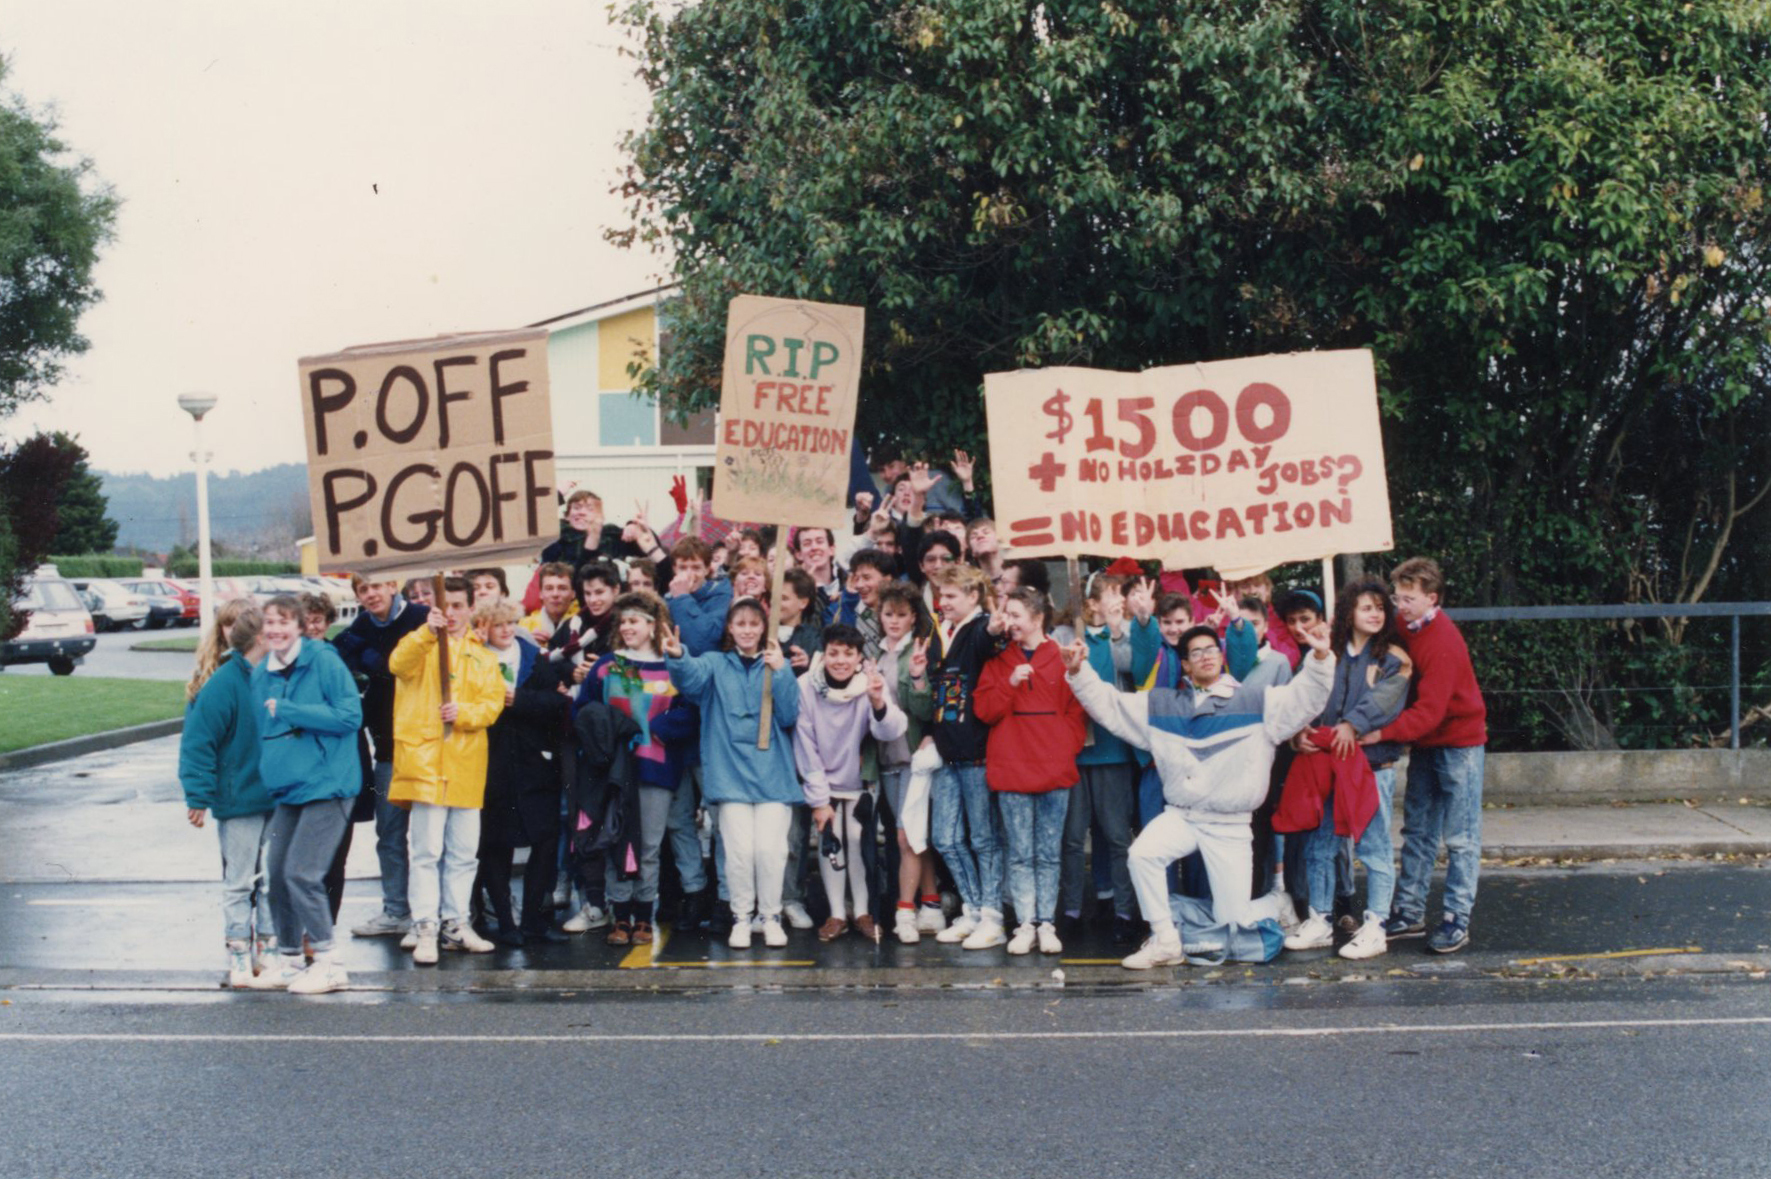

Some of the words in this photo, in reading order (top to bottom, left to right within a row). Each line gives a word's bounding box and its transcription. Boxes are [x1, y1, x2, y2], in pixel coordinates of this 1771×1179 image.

[724, 418, 848, 455] EDUCATION
[1042, 382, 1292, 459] $1500
[1079, 458, 1110, 483] NO
[1118, 445, 1272, 482] HOLIDAY
[1256, 454, 1364, 496] JOBS?
[322, 450, 555, 557] P.GOFF
[1060, 509, 1102, 543] NO
[1111, 497, 1352, 547] EDUCATION
